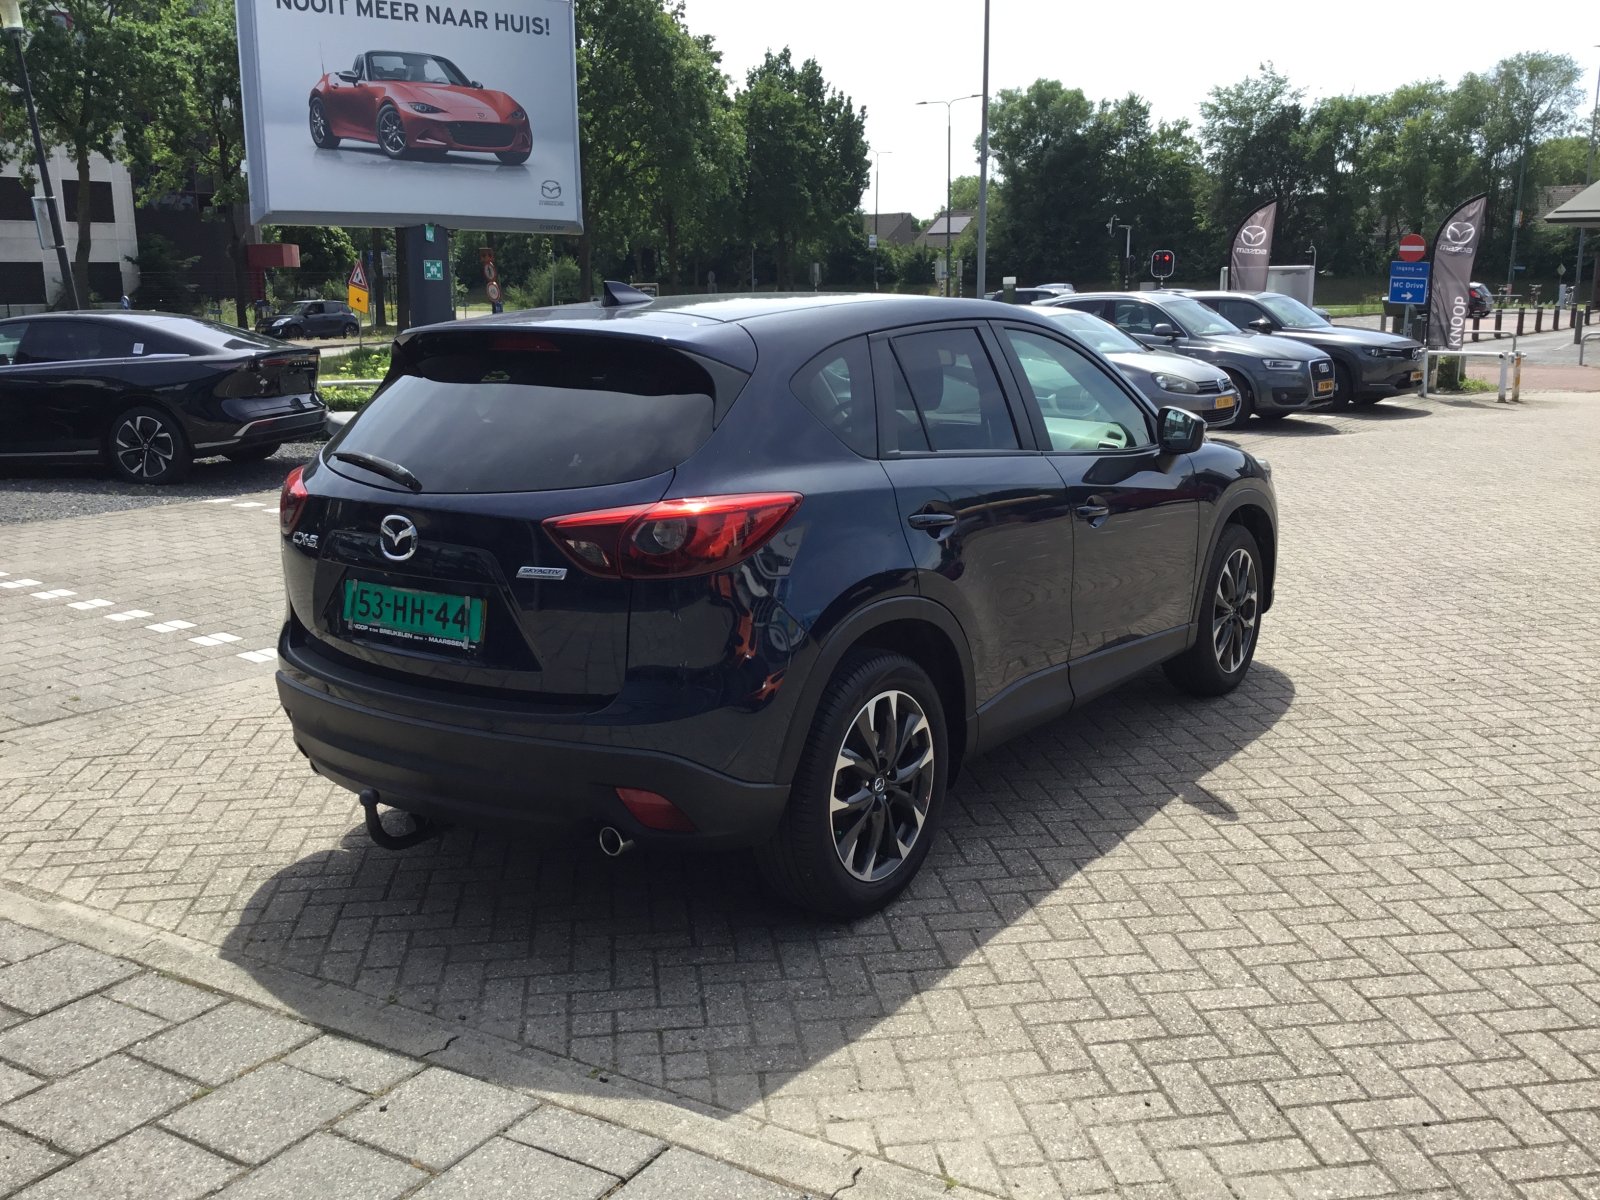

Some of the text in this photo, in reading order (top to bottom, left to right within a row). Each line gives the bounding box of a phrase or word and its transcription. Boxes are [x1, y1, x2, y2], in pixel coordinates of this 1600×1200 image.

[356, 0, 419, 22] MEER
[425, 5, 488, 29] NAAR
[495, 12, 550, 36] HUIS!
[1449, 296, 1467, 346] KNOOP
[522, 567, 562, 575] SKYACTIV
[357, 589, 467, 633] 53-HH-44
